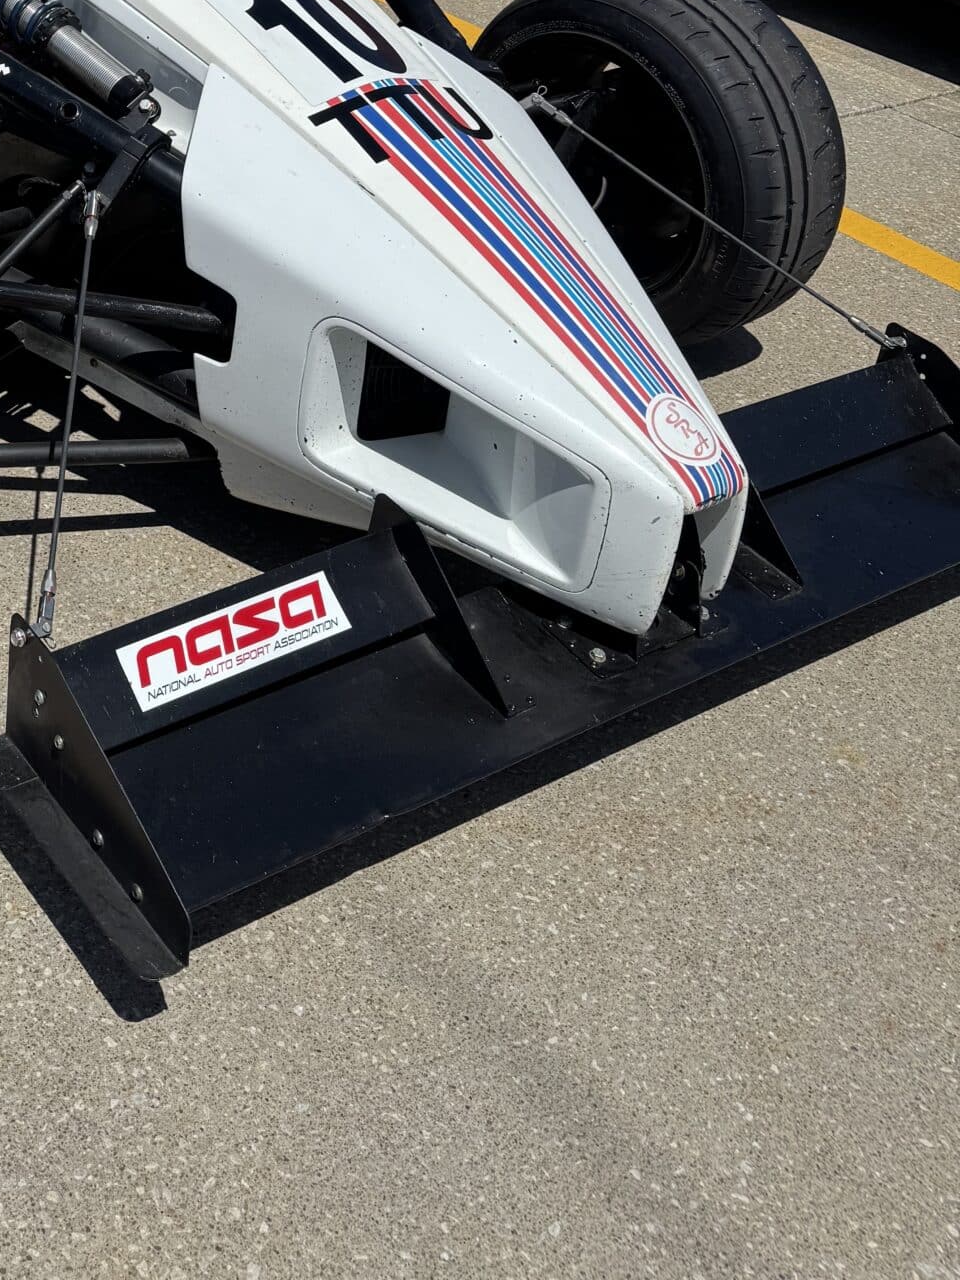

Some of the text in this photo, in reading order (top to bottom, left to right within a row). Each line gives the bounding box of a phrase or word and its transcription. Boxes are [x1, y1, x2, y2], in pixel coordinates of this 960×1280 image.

[136, 579, 327, 688] nasa
[147, 616, 340, 702] NATIONAL AUTO SPORT ASSOCIATION
